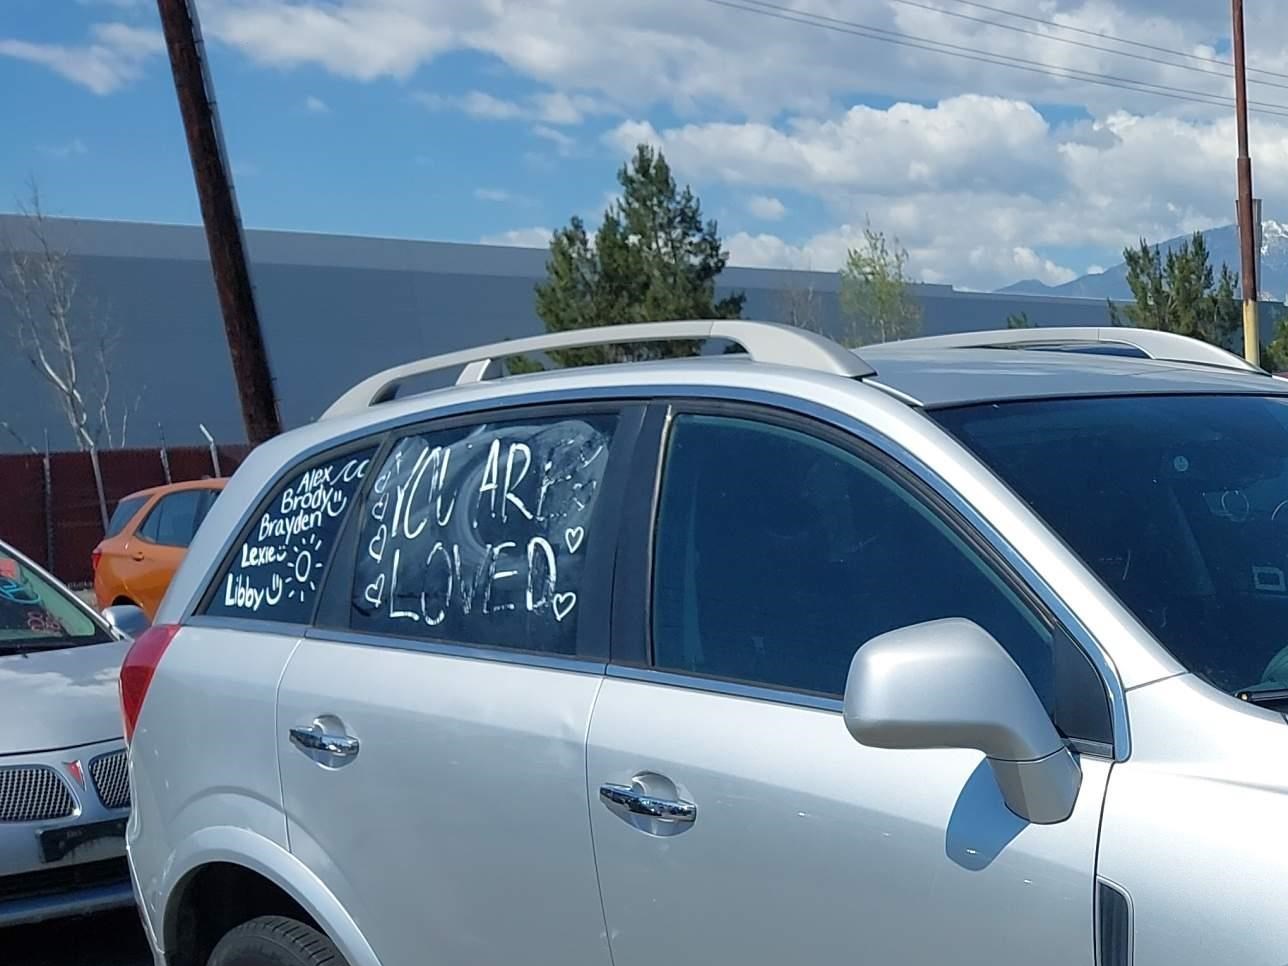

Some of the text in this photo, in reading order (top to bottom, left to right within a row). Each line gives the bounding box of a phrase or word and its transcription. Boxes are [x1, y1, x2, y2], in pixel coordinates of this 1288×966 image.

[297, 466, 333, 494] Alex
[392, 438, 573, 538] YOU ARE
[281, 484, 333, 514] Brody
[258, 510, 322, 545] Brayden
[241, 543, 276, 568] Lexie
[224, 573, 265, 611] Libby
[389, 537, 557, 625] LOVED
